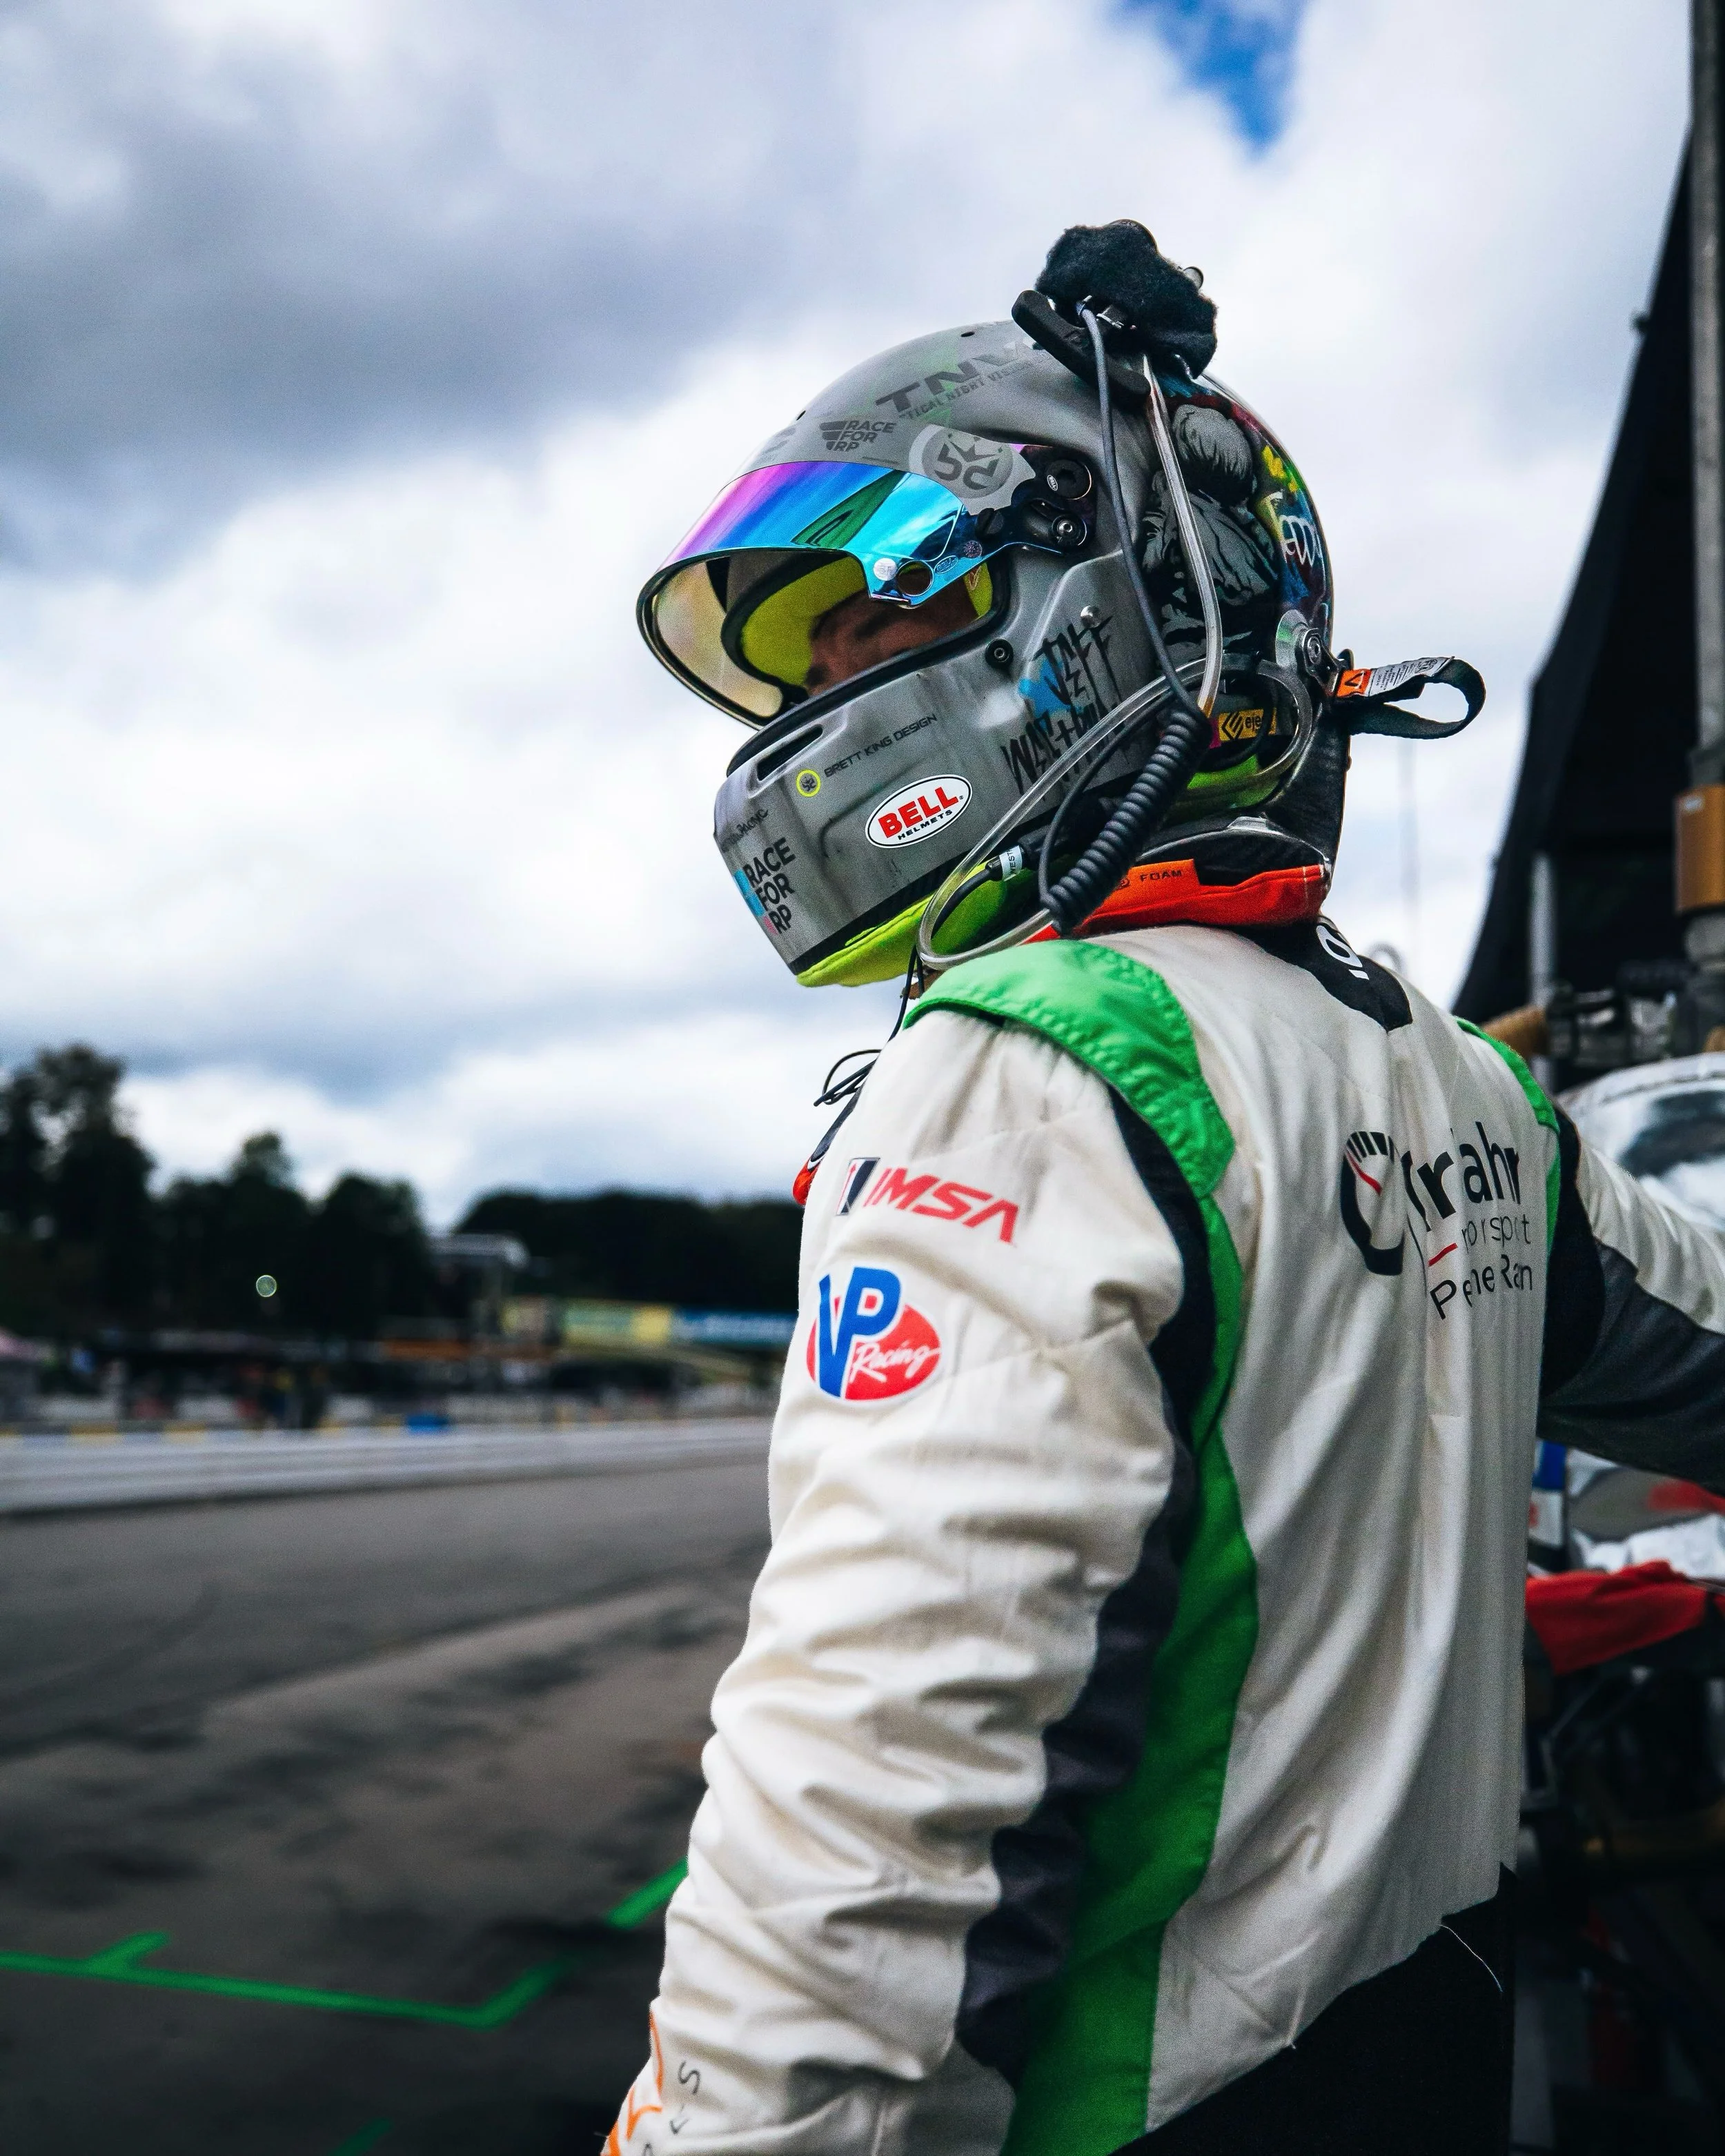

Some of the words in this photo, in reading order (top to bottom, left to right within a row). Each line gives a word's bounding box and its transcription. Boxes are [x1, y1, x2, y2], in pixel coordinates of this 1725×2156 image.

[833, 441, 860, 453] RP
[840, 431, 879, 444] FOR
[846, 419, 896, 434] RACE
[823, 751, 862, 778] BRETT
[863, 735, 894, 758] KING
[894, 713, 938, 743] DESIGN
[878, 787, 959, 839] BELL
[897, 809, 954, 841] HELMETS
[743, 837, 796, 888] RACE
[1140, 869, 1182, 882] FOAM
[756, 872, 795, 913] FOR
[769, 904, 793, 934] RP
[836, 1157, 1020, 1245] IMSA
[818, 1266, 902, 1398] VP
[849, 1340, 943, 1384] Racing
